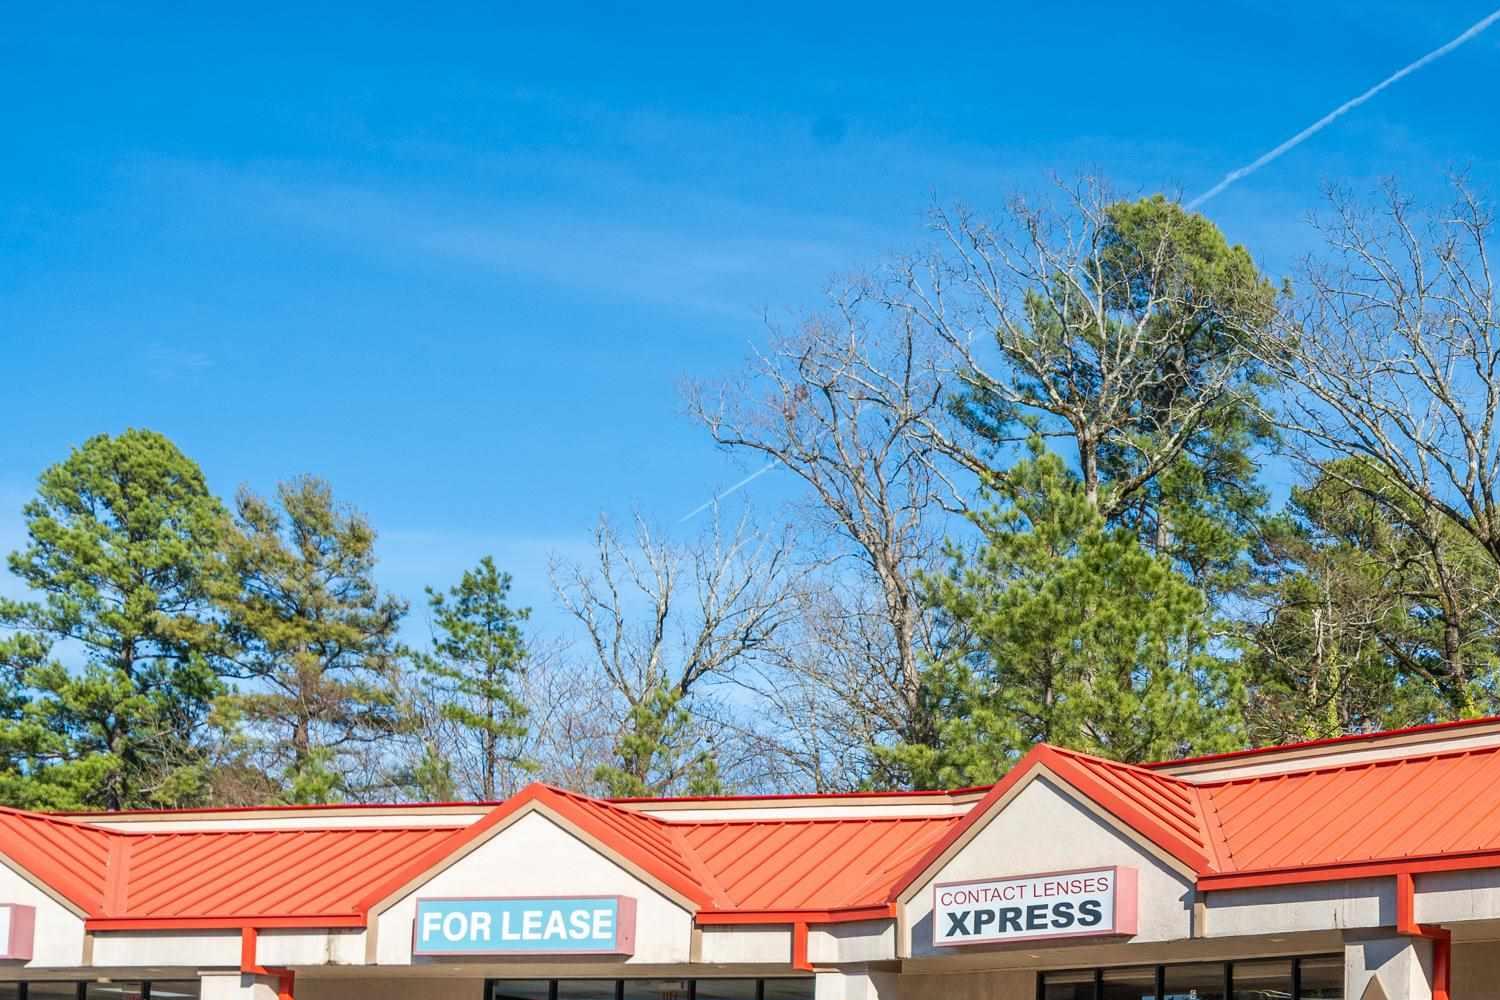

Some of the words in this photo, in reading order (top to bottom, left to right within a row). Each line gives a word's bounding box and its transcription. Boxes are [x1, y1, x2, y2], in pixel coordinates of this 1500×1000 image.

[940, 884, 1027, 906] CONTACT
[1032, 876, 1109, 898] LENSES
[422, 911, 491, 943] FOR
[501, 908, 613, 941] LEASE
[945, 899, 1102, 937] XPRESS
